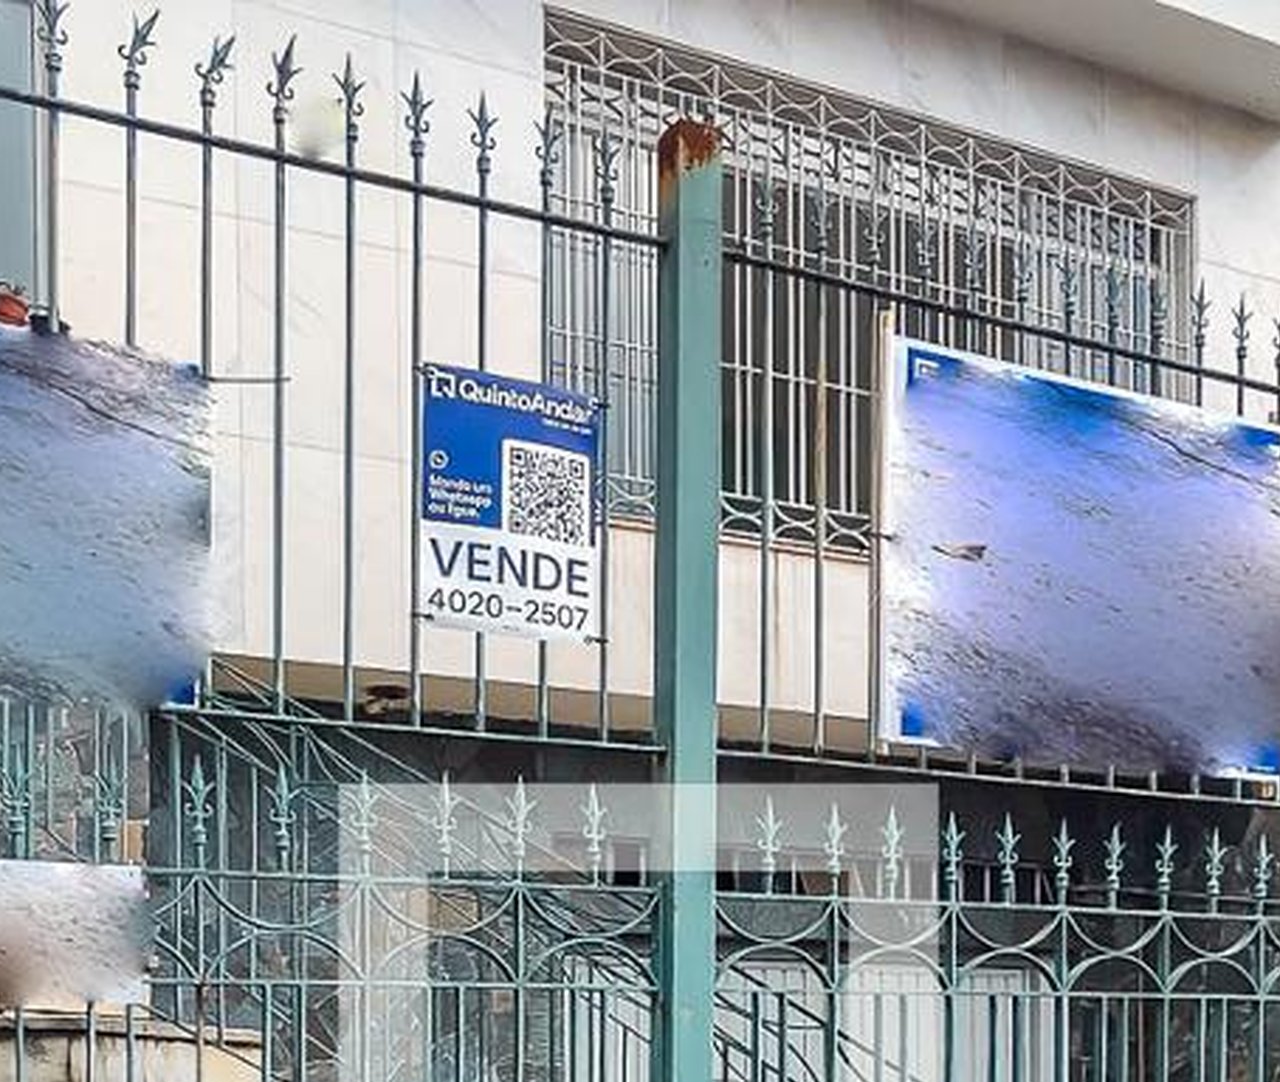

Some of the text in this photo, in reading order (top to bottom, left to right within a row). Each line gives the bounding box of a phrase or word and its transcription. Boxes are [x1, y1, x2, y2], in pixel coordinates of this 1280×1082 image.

[459, 379, 593, 422] QuintoAndar
[429, 538, 589, 598] VENDE
[428, 588, 590, 631] 4020-2507
